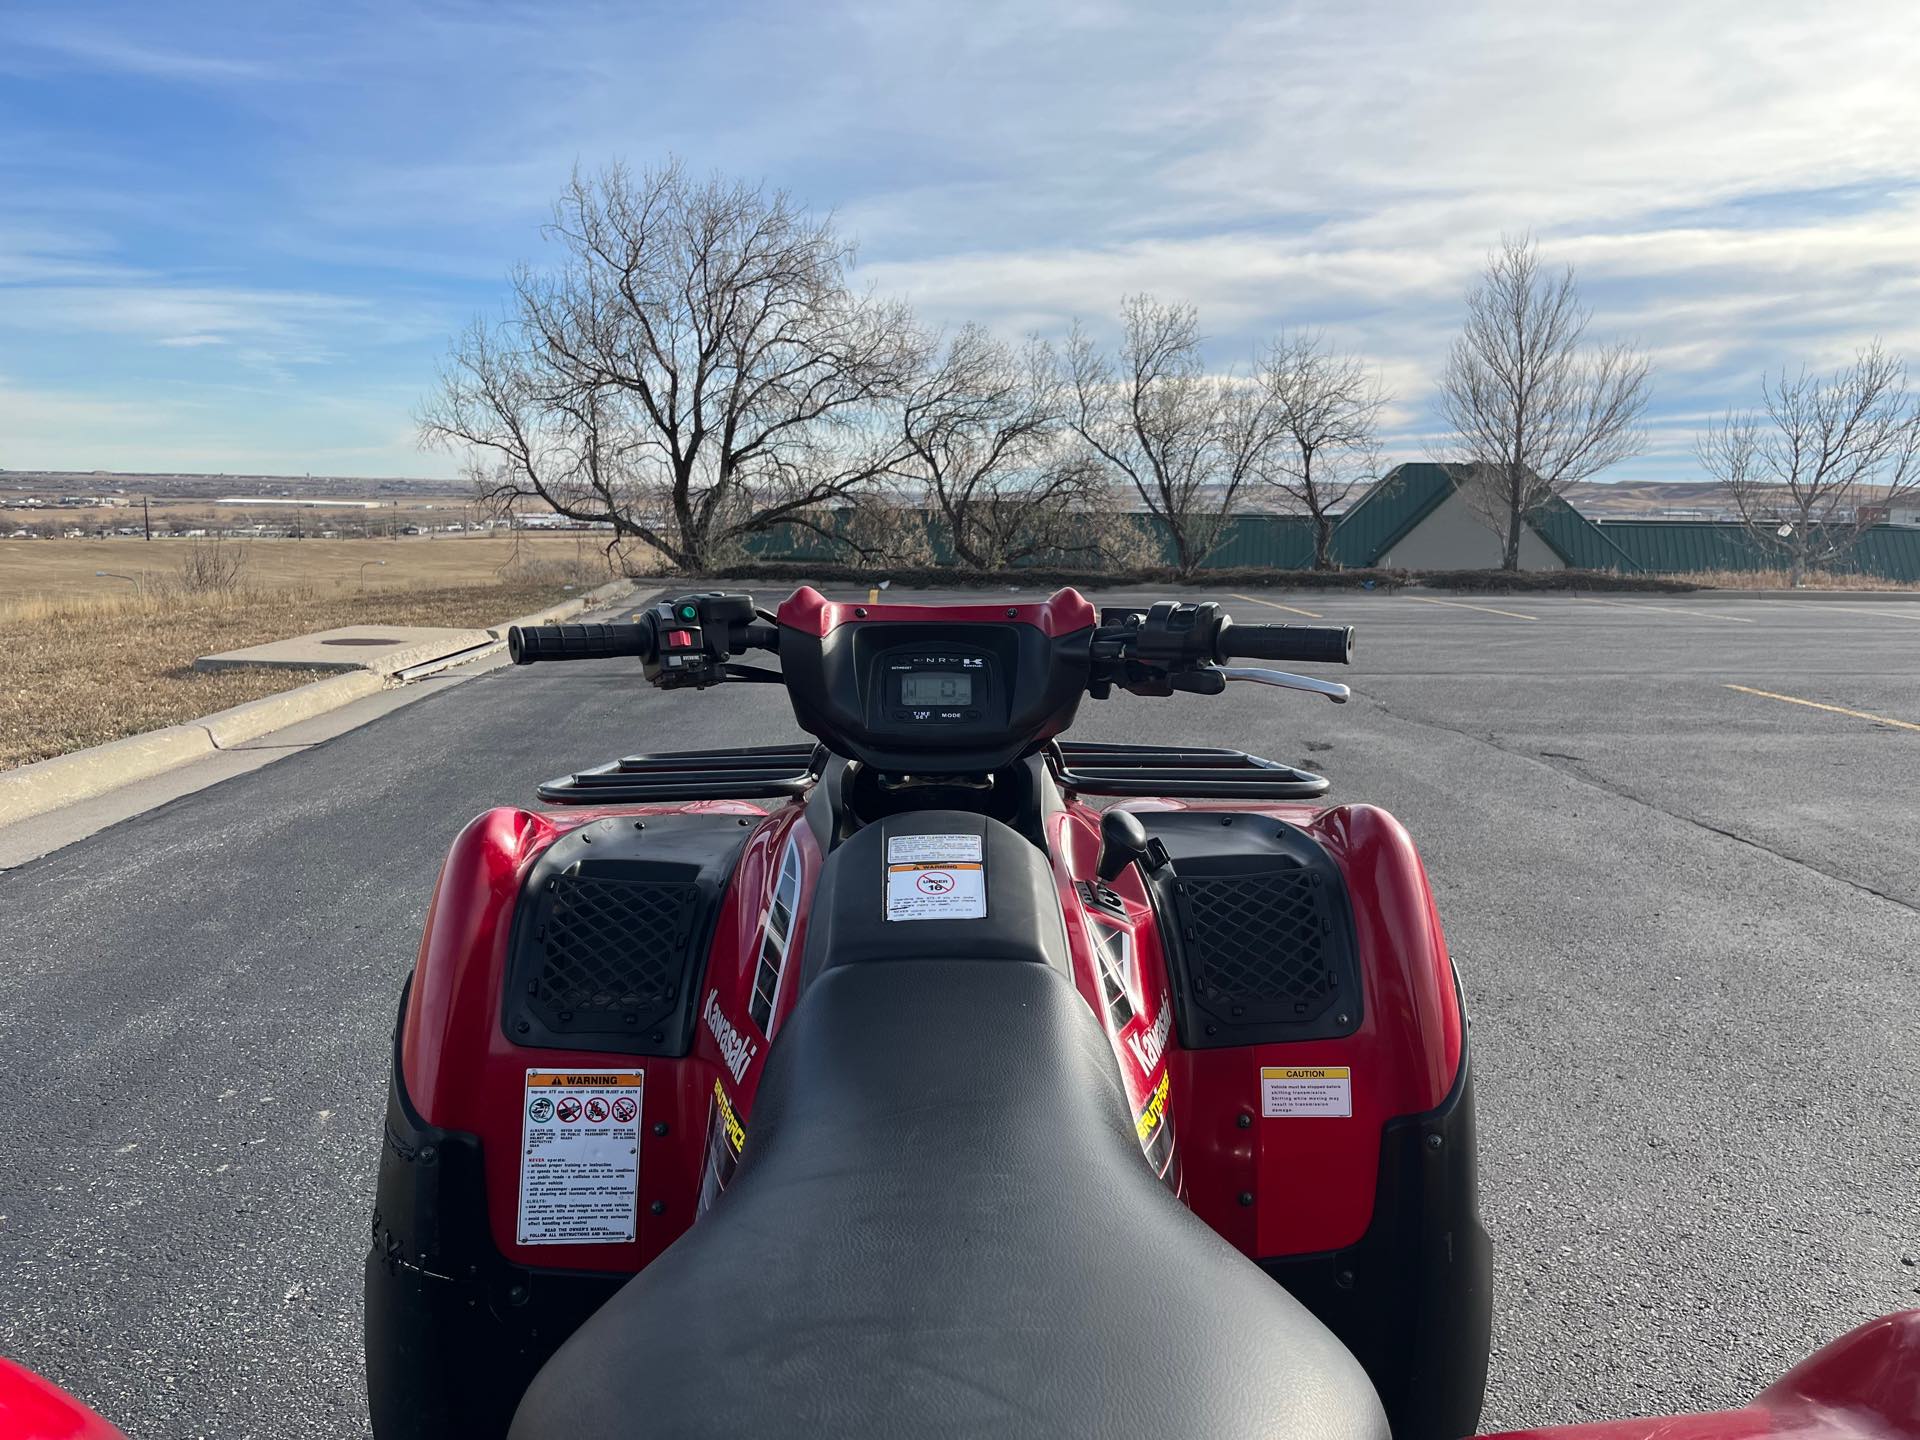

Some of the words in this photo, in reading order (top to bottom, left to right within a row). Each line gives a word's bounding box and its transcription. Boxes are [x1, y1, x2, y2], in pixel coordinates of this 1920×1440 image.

[703, 988, 757, 1086] Kawasaki
[1127, 987, 1171, 1078] Kawasaki
[567, 1076, 617, 1084] WARNING
